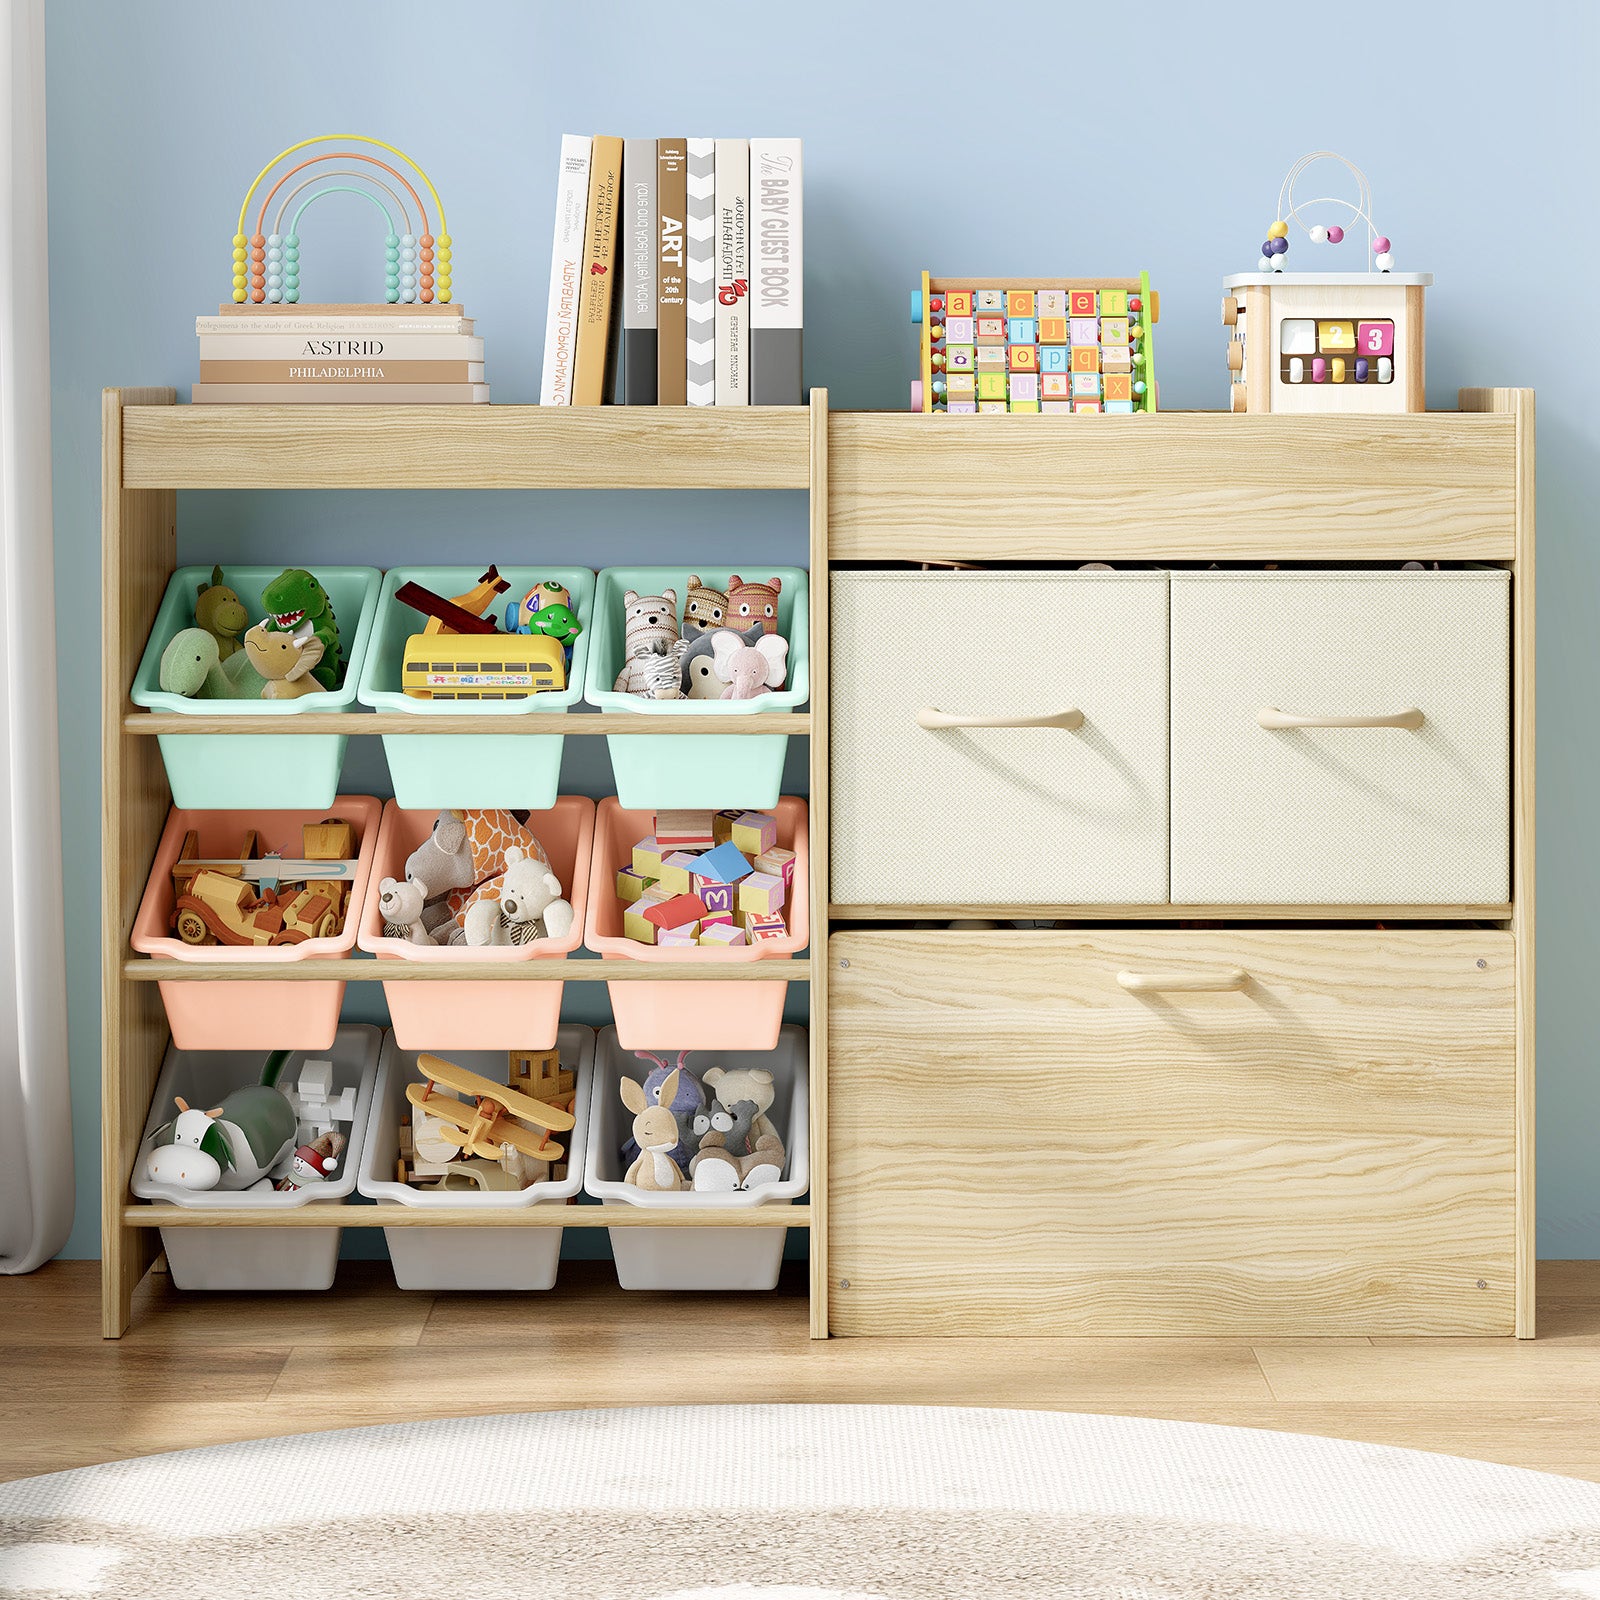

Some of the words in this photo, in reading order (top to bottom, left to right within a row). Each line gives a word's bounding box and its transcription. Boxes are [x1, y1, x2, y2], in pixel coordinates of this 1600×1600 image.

[760, 179, 789, 215] BABY
[662, 215, 683, 267] ART
[760, 219, 789, 263] GUEST
[663, 276, 670, 284] of
[671, 276, 682, 284] the
[760, 267, 789, 307] BOOK
[660, 296, 685, 305] Century
[953, 298, 965, 310] a
[1077, 296, 1089, 309] e
[1111, 295, 1117, 311] f
[954, 322, 965, 338] g
[1020, 322, 1024, 339] i
[1329, 326, 1344, 344] 2
[1368, 329, 1383, 350] 3
[1050, 351, 1061, 369] p
[1079, 351, 1091, 369] q
[289, 367, 385, 378] PHILADELPHIA
[989, 377, 996, 392] t
[1018, 382, 1029, 394] u
[706, 889, 728, 910] M
